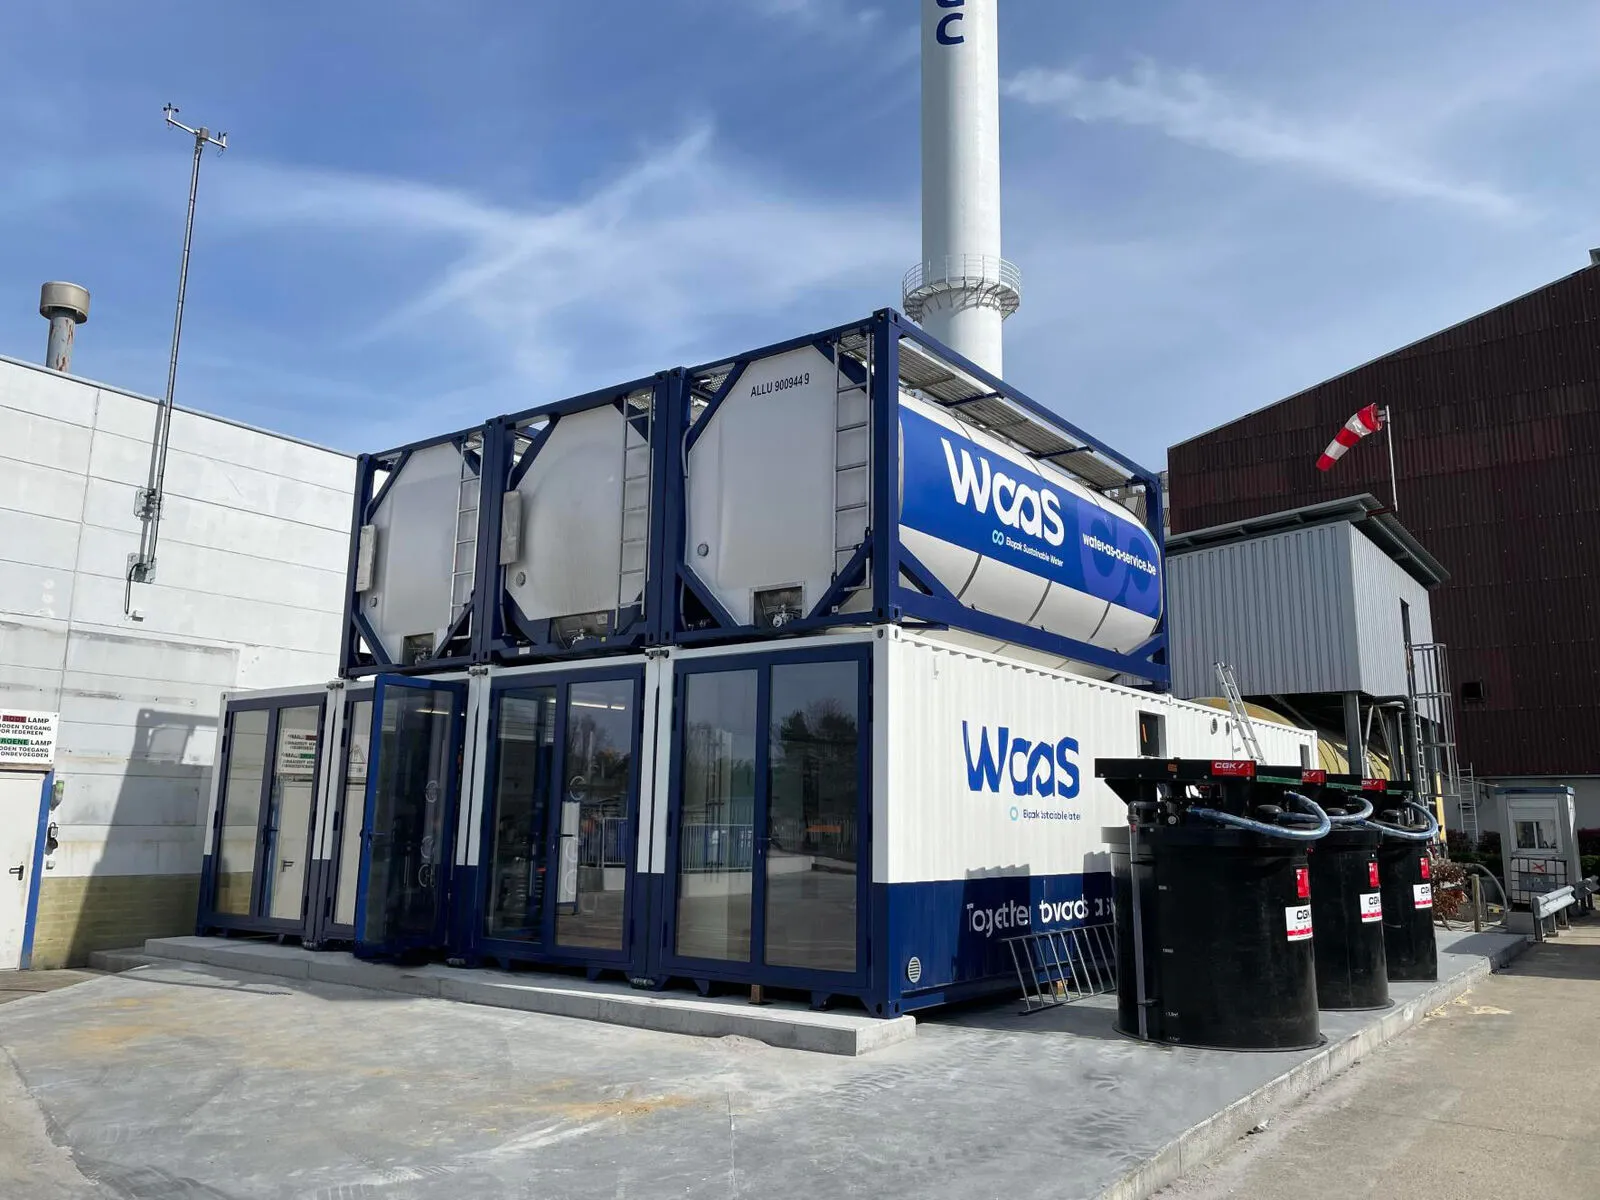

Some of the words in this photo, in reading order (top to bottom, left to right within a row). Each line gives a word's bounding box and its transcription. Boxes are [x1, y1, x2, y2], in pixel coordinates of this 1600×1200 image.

[750, 382, 773, 398] ALLU
[774, 373, 803, 392] 900944
[1082, 533, 1157, 575] water-as-a-service.be
